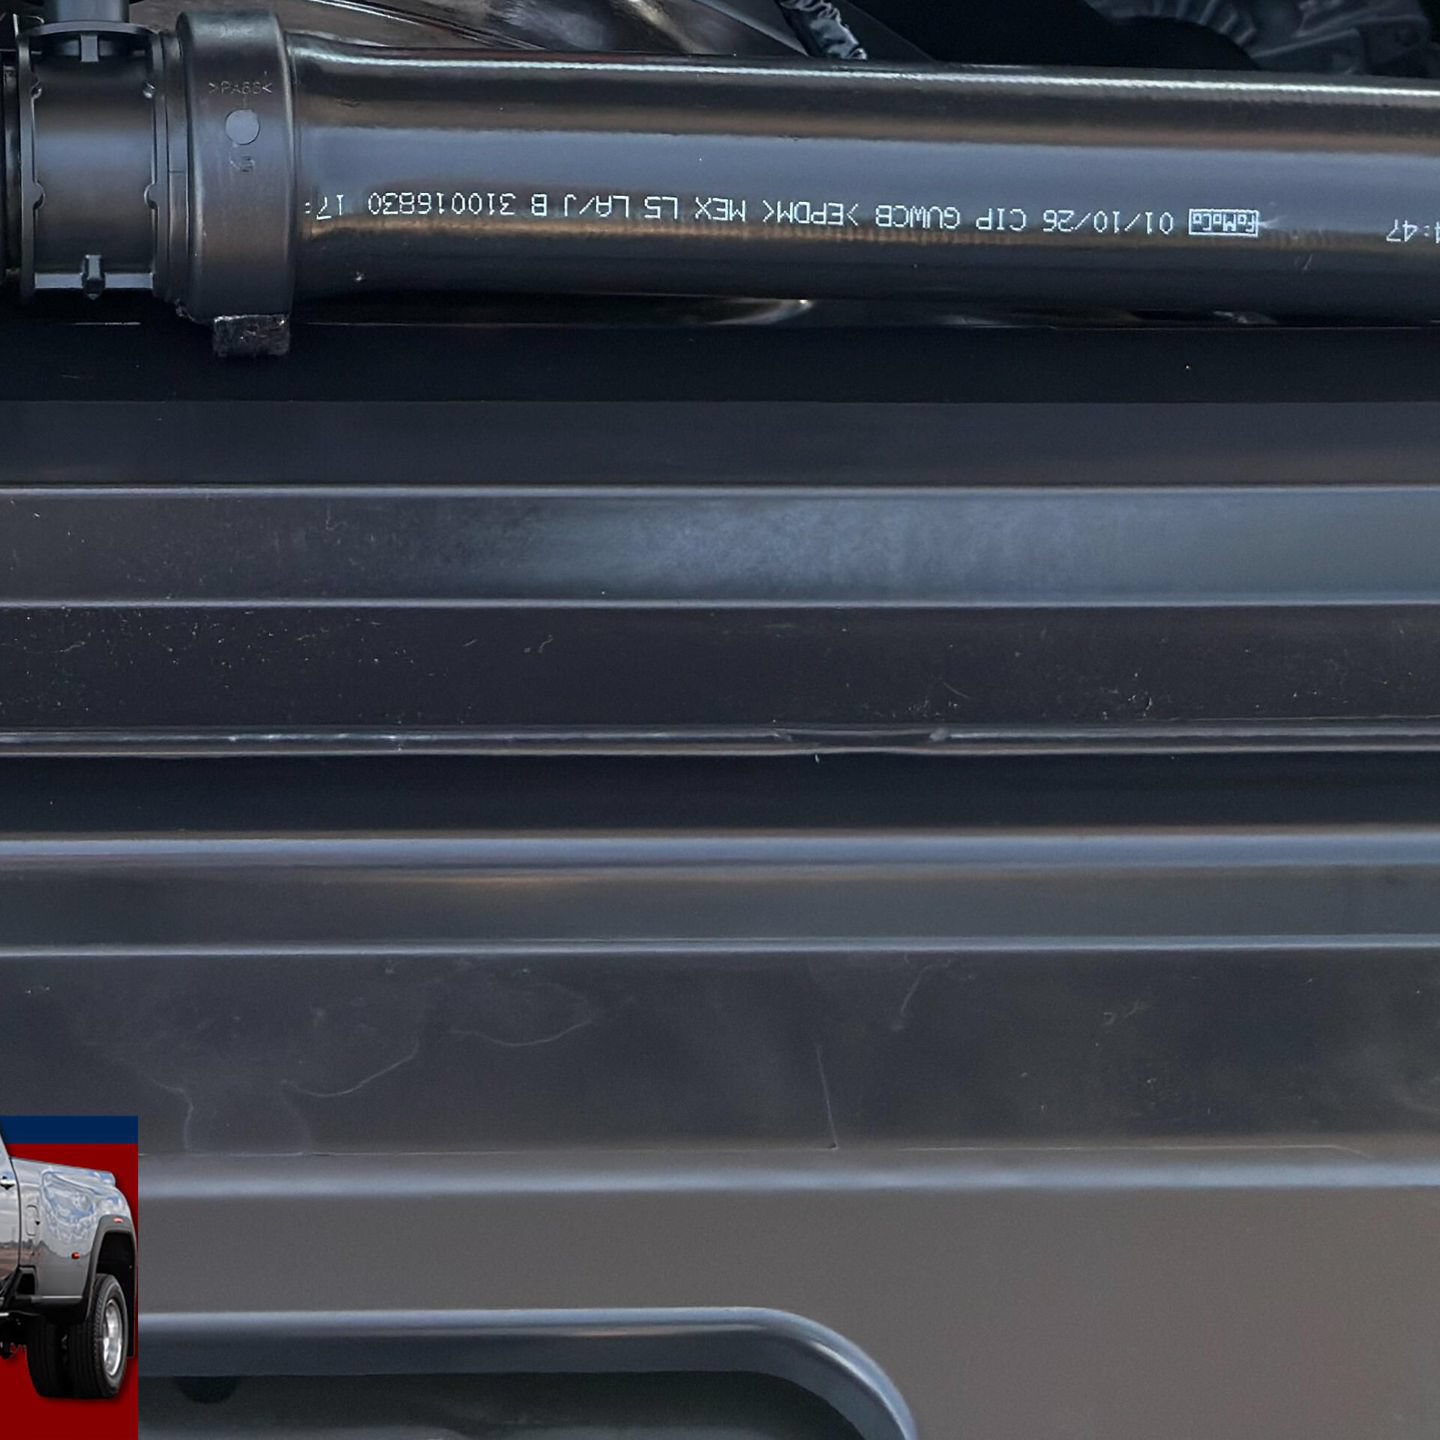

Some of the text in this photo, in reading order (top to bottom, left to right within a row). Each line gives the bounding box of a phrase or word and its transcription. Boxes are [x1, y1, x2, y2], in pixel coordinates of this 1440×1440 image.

[368, 191, 517, 216] 310016830
[531, 193, 547, 216] B
[694, 195, 746, 221] MEX
[875, 204, 961, 229] GUWCB
[975, 207, 1027, 231] CIP
[1042, 208, 1174, 234] 01/10/26
